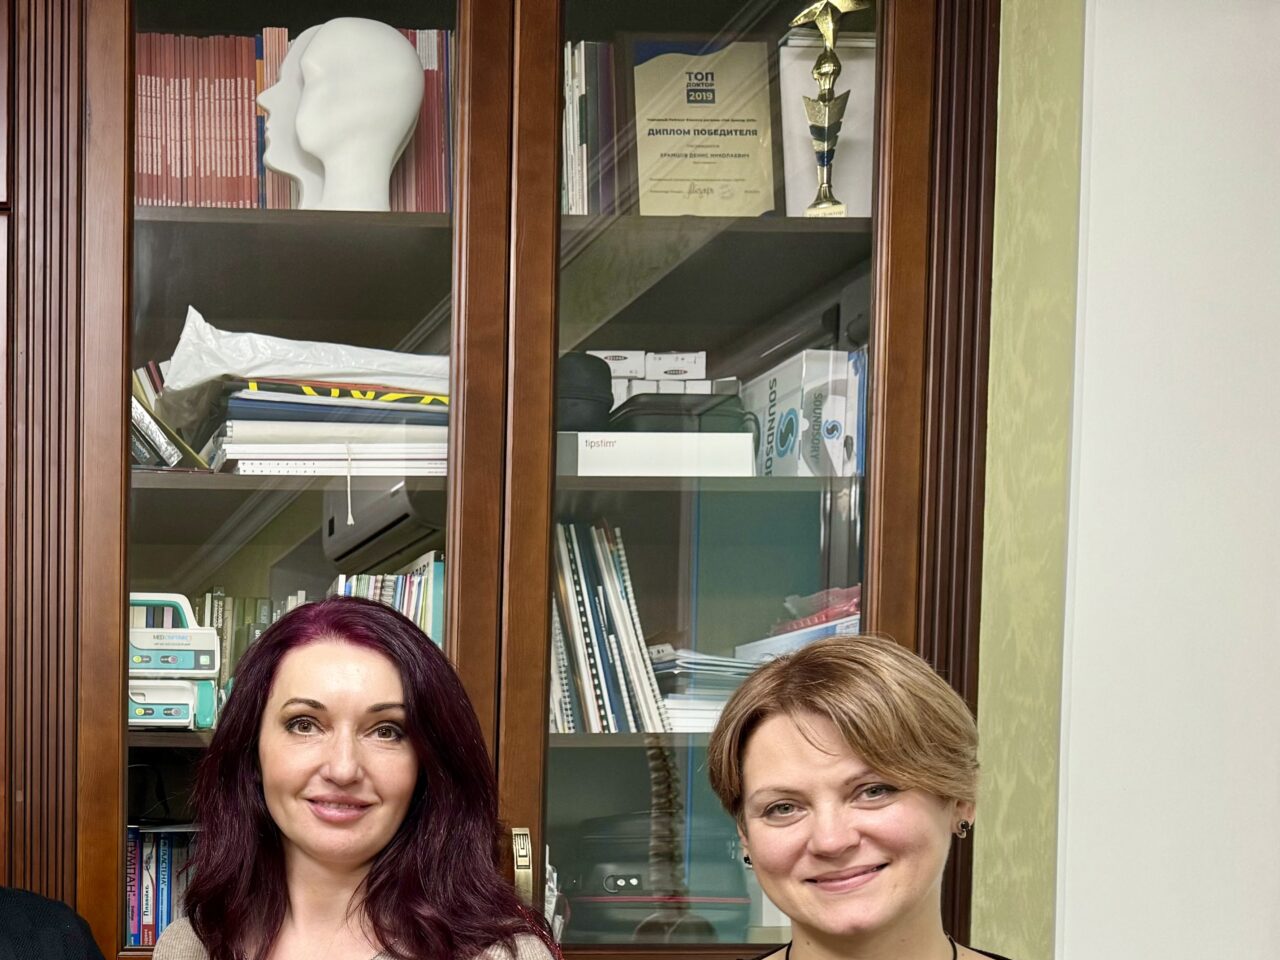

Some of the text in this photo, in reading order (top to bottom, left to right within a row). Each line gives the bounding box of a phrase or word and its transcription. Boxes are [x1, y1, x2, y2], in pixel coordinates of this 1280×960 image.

[685, 71, 714, 82] ТОП
[688, 91, 713, 101] 2019
[647, 128, 758, 137] ДИПЛОМ ПОБЕДИТЕЛЯ
[765, 377, 777, 477] SOUNDSO
[810, 392, 823, 460] SOUNDSORY
